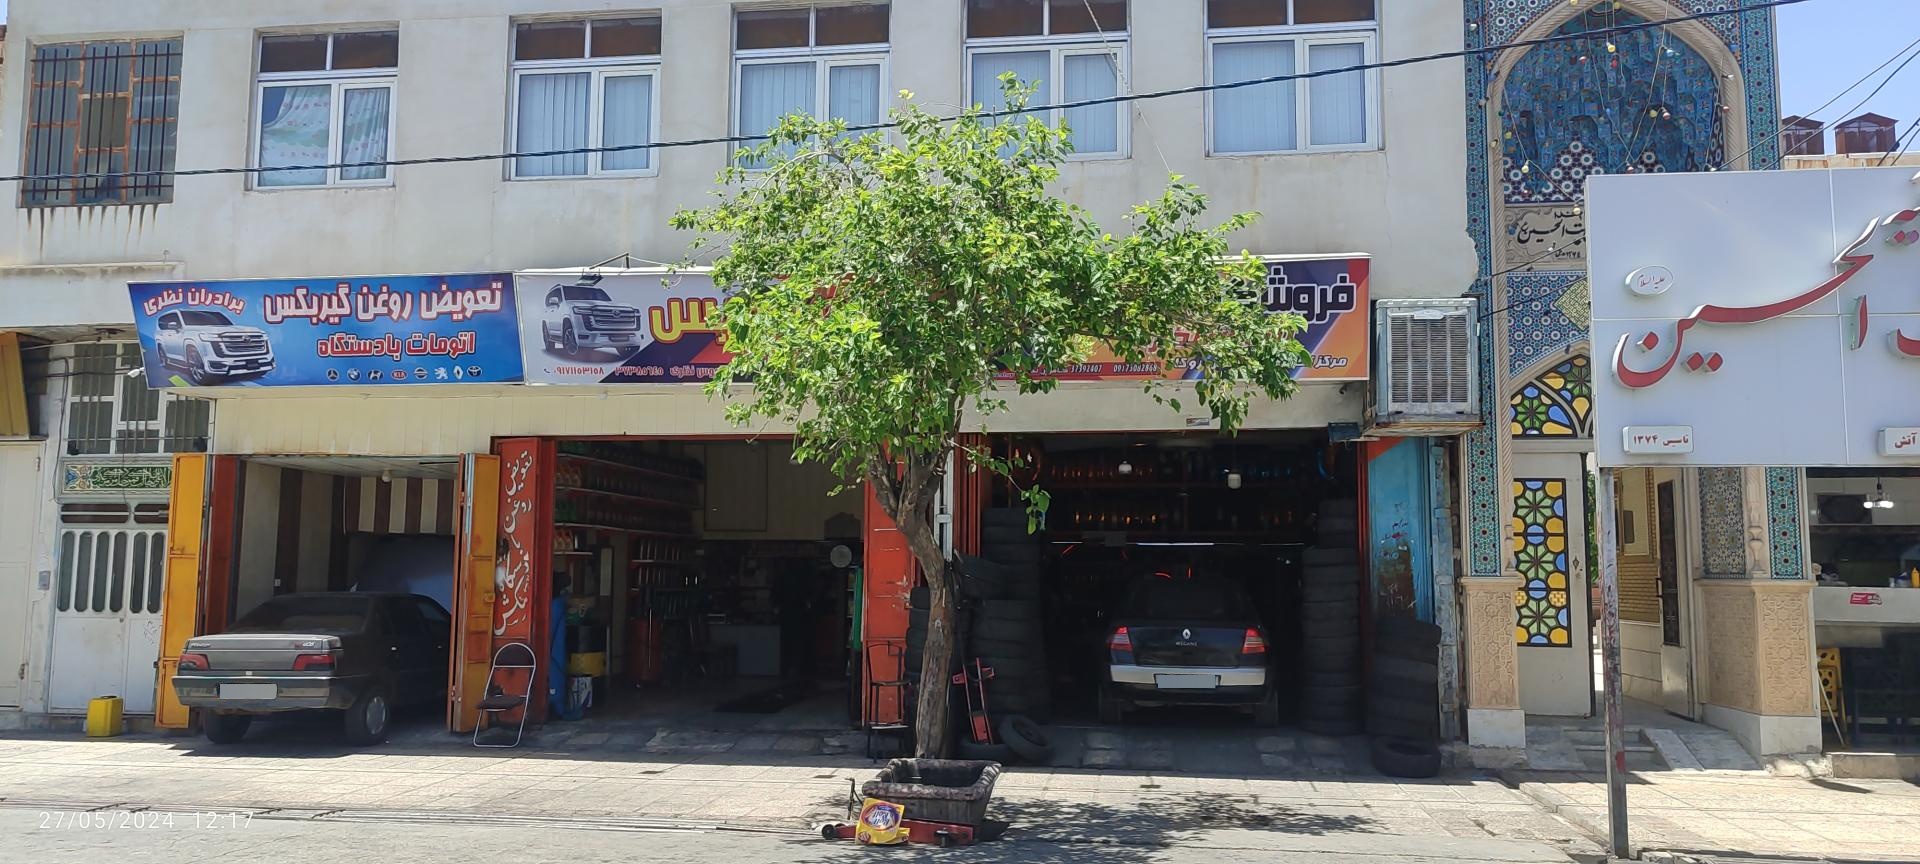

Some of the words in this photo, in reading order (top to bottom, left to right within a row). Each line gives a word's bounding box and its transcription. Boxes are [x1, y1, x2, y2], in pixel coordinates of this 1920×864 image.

[143, 287, 184, 317] نظری
[187, 287, 246, 316] برادران
[263, 282, 353, 325] گیربکس
[357, 284, 412, 322] روغن
[420, 280, 504, 322] تعویض
[405, 331, 477, 358] اتومات
[393, 370, 406, 379] KIA
[1313, 354, 1349, 369] مرکز
[1633, 434, 1658, 445] ۱۳۷۴
[1895, 431, 1918, 449] آتش
[505, 450, 533, 497] تعویض
[504, 497, 532, 534] روغن
